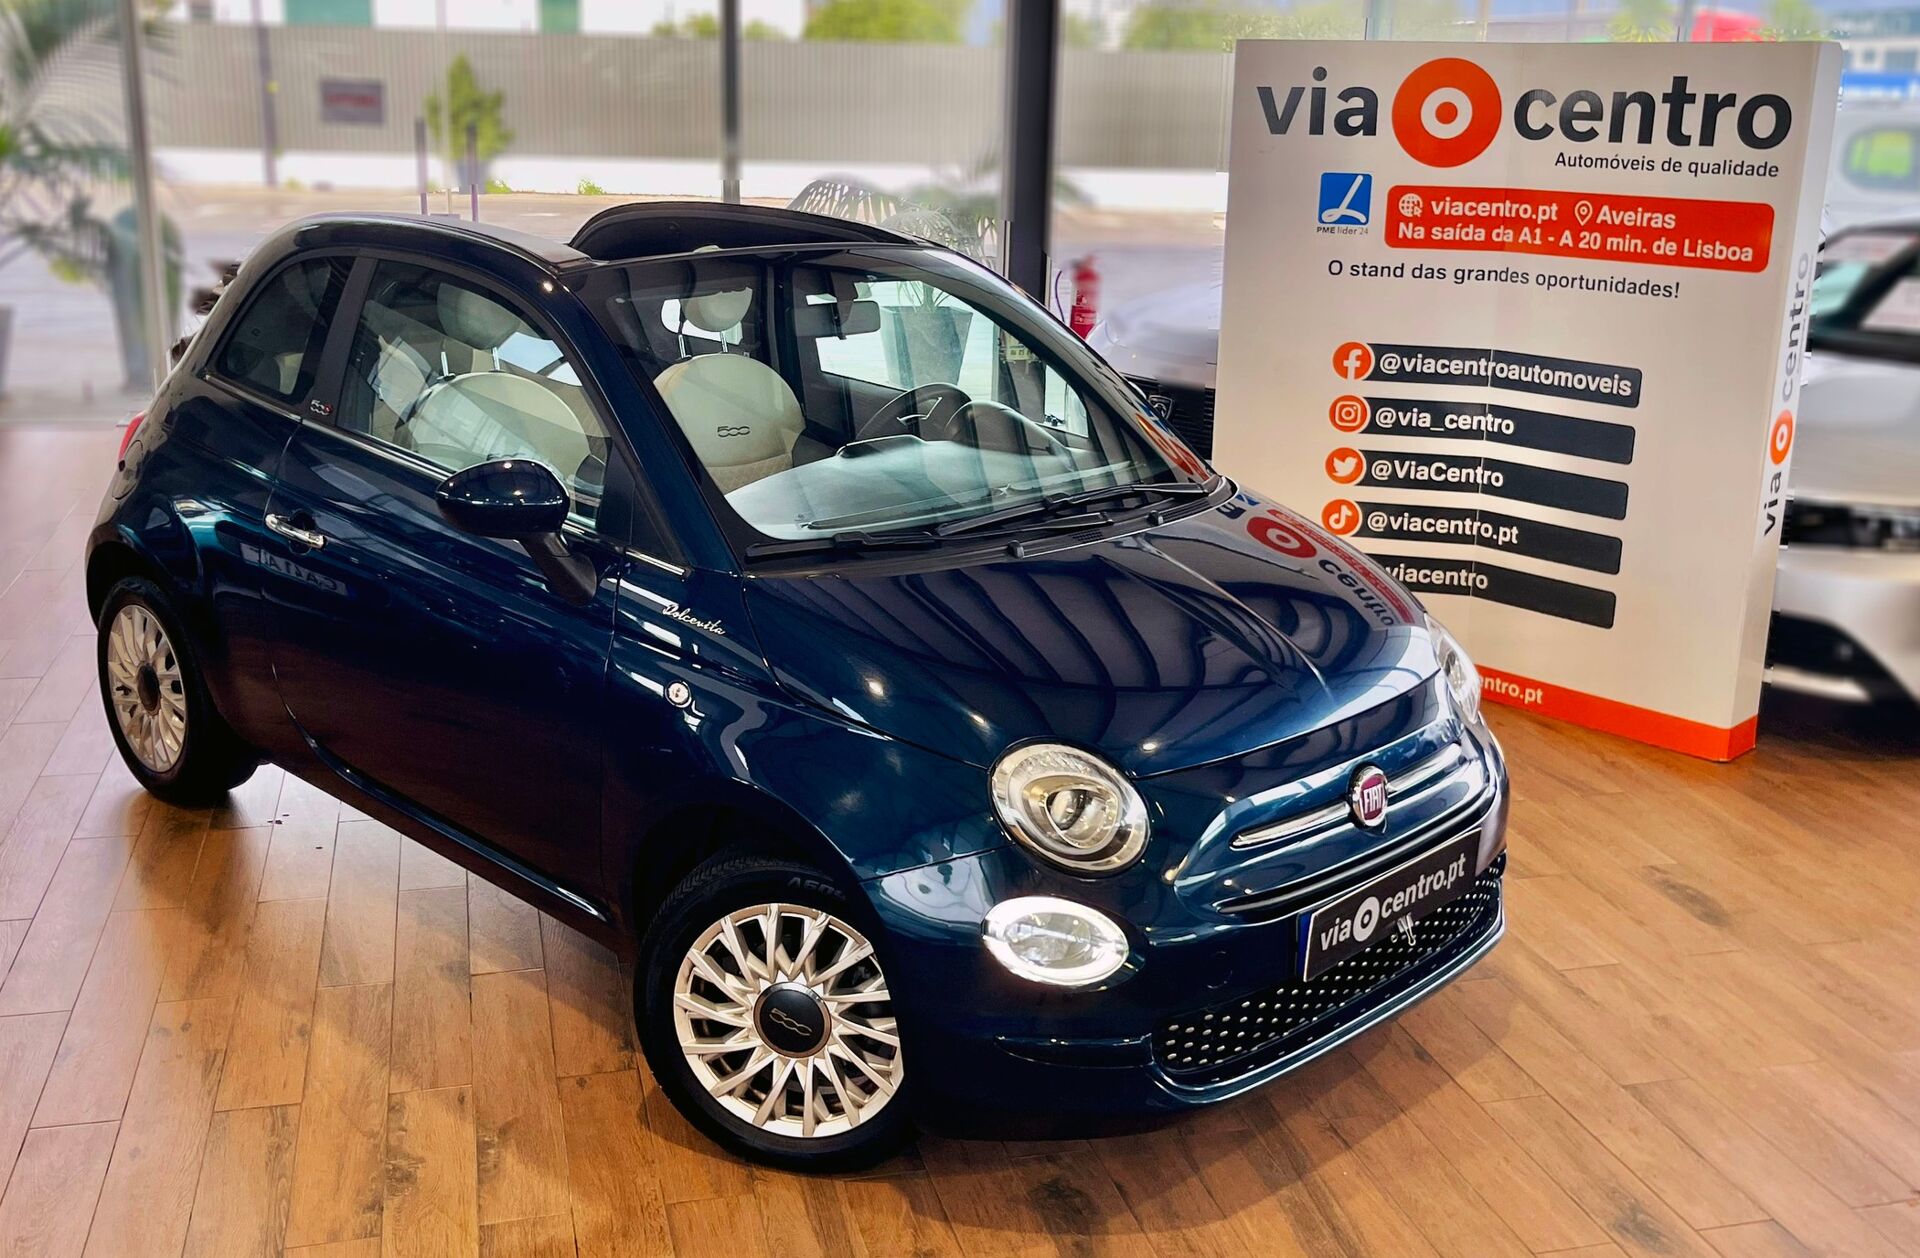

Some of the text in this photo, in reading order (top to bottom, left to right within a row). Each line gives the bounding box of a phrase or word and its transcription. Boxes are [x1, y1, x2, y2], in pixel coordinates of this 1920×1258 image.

[1256, 66, 1792, 150] via centro
[1555, 152, 1779, 178] Automóveis de qualidade
[1431, 196, 1558, 224] viacentro.pt
[1596, 205, 1676, 229] Aveiras
[1316, 226, 1336, 234] PME
[1398, 222, 1425, 240] Na
[1431, 223, 1486, 241] saída
[1491, 225, 1514, 242] da
[1518, 226, 1542, 245] A1
[1559, 230, 1574, 248] A
[1578, 231, 1601, 250] 20
[1606, 234, 1648, 253] min.
[1652, 237, 1677, 256] de
[1683, 238, 1753, 262] Lisboa
[1328, 260, 1680, 299] O stand das grandes oportunidades!
[1379, 353, 1632, 397] @viacentroautomoveis
[1763, 471, 1782, 537] via
[1782, 251, 1809, 403] centro
[1375, 407, 1515, 435] @via_centro
[1371, 459, 1504, 487] @ViaCentro
[1367, 511, 1519, 544] @viacentro.pt
[1385, 562, 1488, 590] viacentro
[662, 604, 726, 635] Dolcevita
[1480, 675, 1544, 705] ntro.pt
[1363, 782, 1384, 814] FIAT
[1320, 853, 1467, 951] via centro.pt
